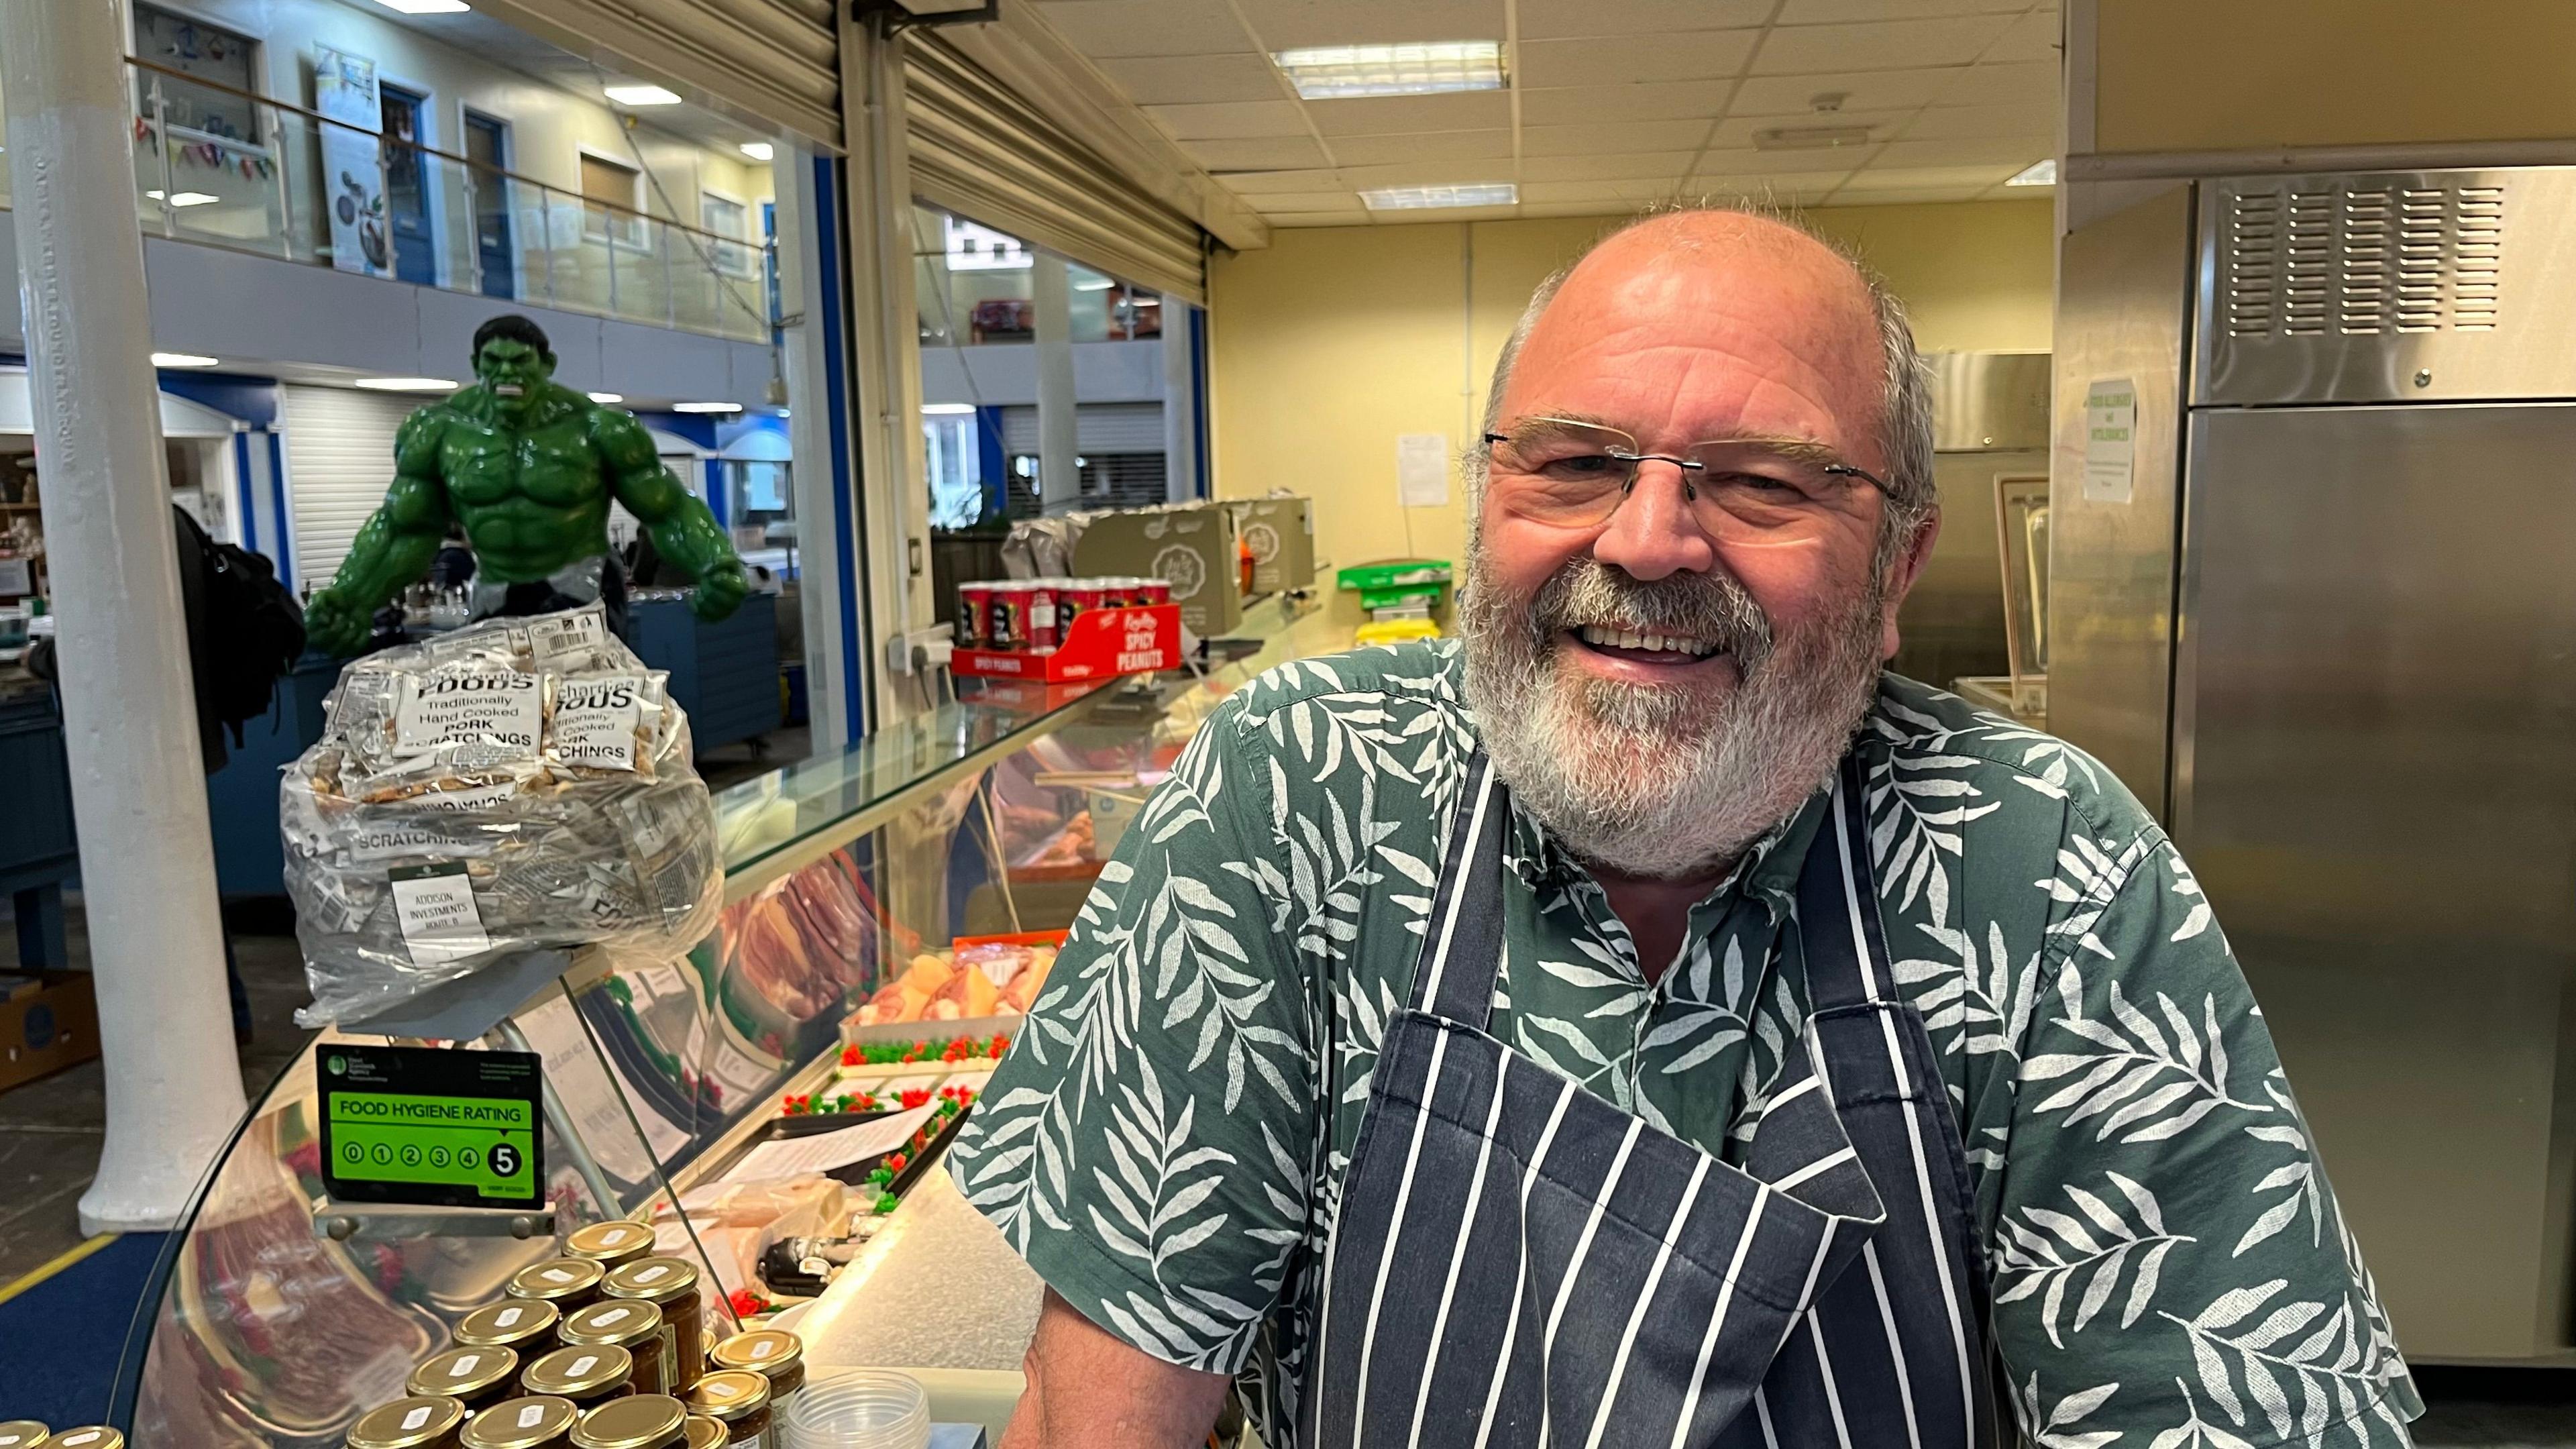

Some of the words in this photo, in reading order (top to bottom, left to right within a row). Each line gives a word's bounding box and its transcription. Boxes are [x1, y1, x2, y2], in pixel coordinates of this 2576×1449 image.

[1125, 631, 1157, 651] SPICY
[1117, 649, 1164, 672] PEANUTS
[429, 696, 512, 710] Traditionally
[420, 712, 458, 724] Hand
[463, 707, 519, 718] Cooked
[445, 718, 494, 733] PORK
[564, 722, 615, 737] Cooked
[559, 746, 625, 758] CHINGS
[415, 892, 453, 906] ADDISON
[410, 903, 468, 920] INVESTMENTS
[339, 1100, 388, 1116] FOOD
[392, 1104, 460, 1120] HYGIENE
[464, 1106, 522, 1122] RATING
[496, 1148, 515, 1174] 5
